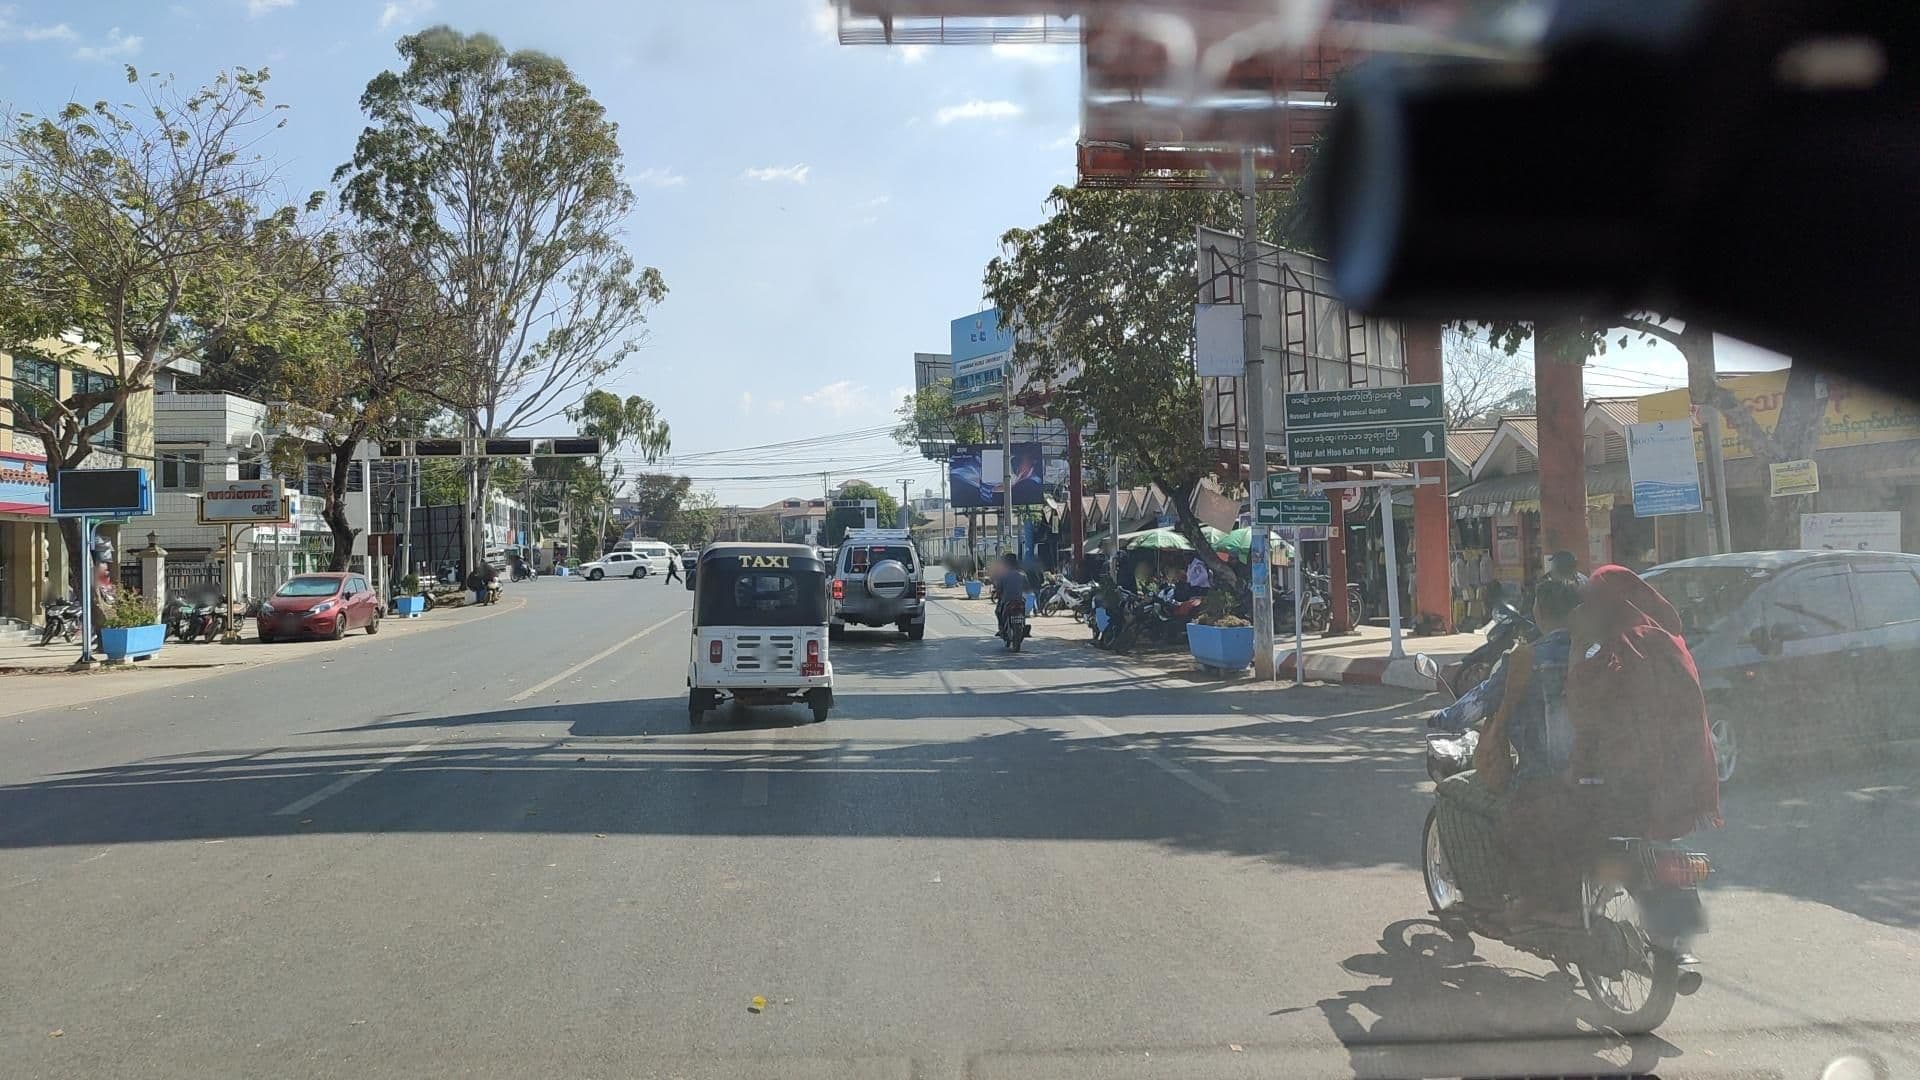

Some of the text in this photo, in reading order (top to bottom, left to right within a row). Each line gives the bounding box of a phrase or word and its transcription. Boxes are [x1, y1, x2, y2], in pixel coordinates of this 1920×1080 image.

[1369, 407, 1387, 415] Garden
[1294, 445, 1395, 458] Mahar Ant Htoo Kan Thar Pagoda
[739, 555, 789, 569] TAXI
